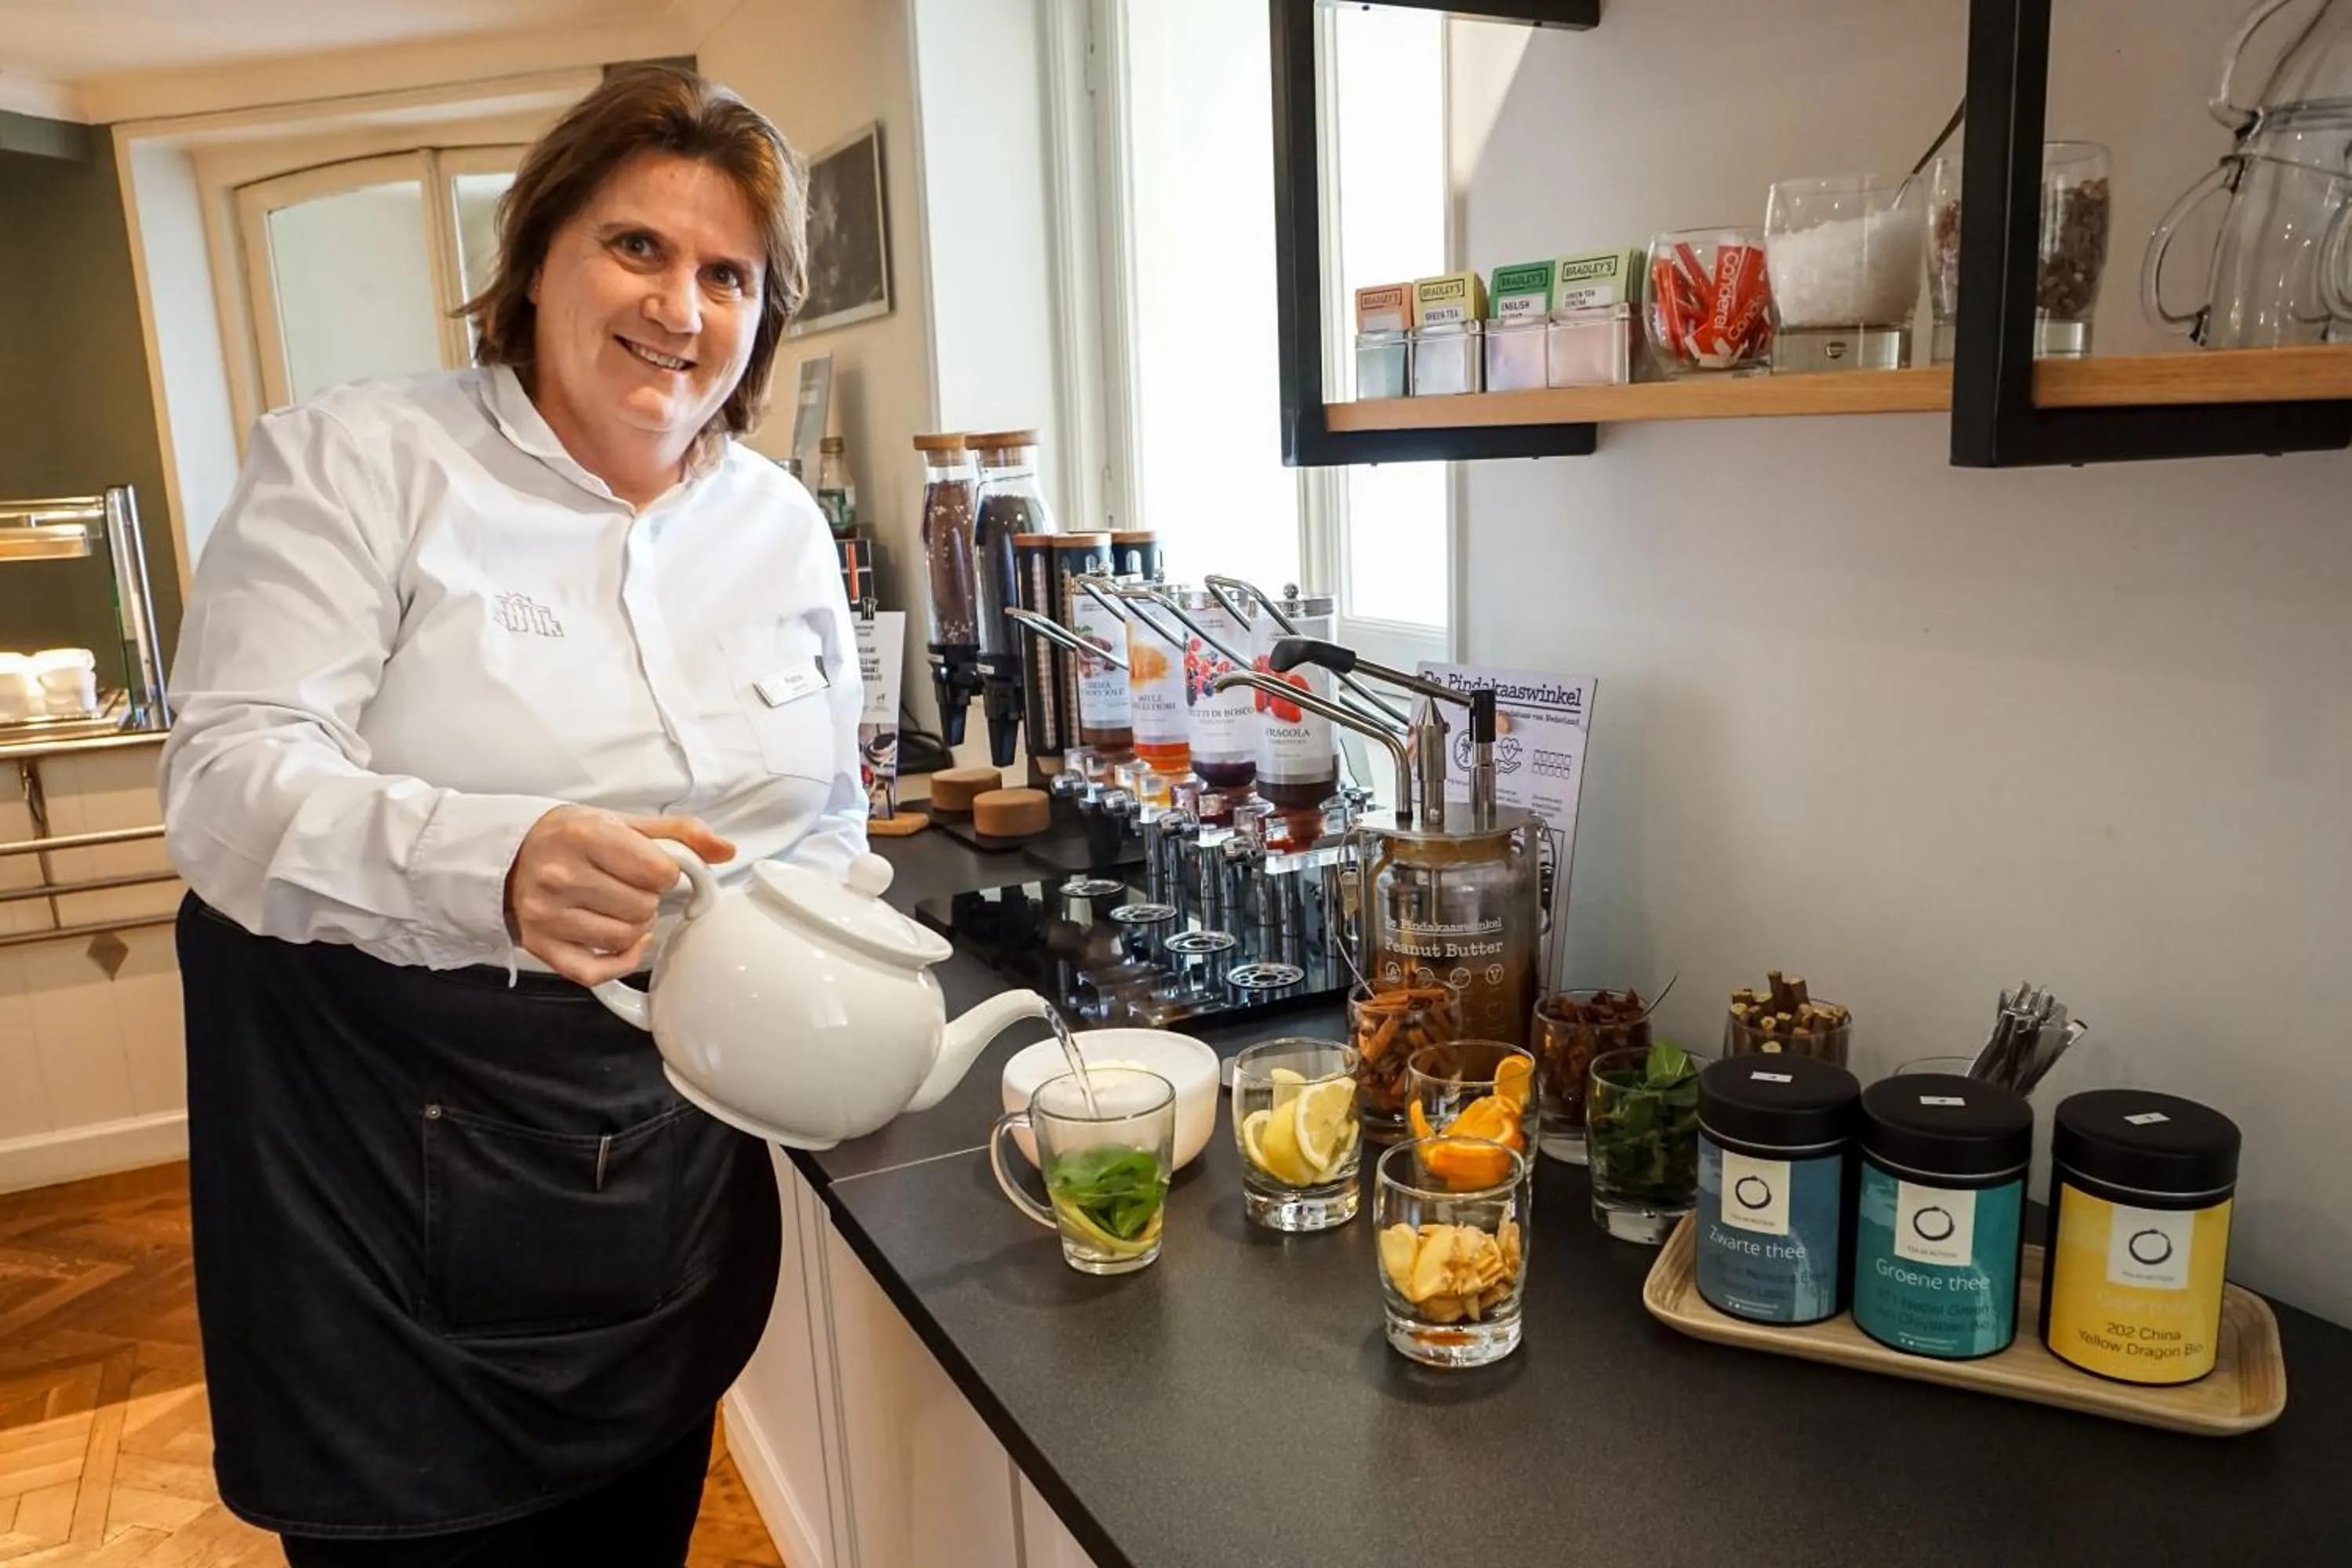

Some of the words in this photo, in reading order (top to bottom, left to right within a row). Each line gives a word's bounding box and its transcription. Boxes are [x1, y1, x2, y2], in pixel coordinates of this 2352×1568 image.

[1566, 261, 1613, 277] BRADLEY'S
[1425, 310, 1445, 321] GREEN
[1446, 308, 1459, 318] TEA
[1501, 300, 1531, 311] ENGLISH
[1385, 938, 1441, 957] Peanut
[1444, 940, 1504, 957] Butter
[1708, 1225, 1761, 1256] Zwarte
[1766, 1243, 1806, 1259] thee
[1876, 1258, 1943, 1290] Groene
[1948, 1276, 1991, 1291] thee
[2106, 1321, 2136, 1338] 202
[2139, 1327, 2182, 1341] China
[2078, 1328, 2122, 1353] Yellow
[2126, 1342, 2181, 1360] Dragon
